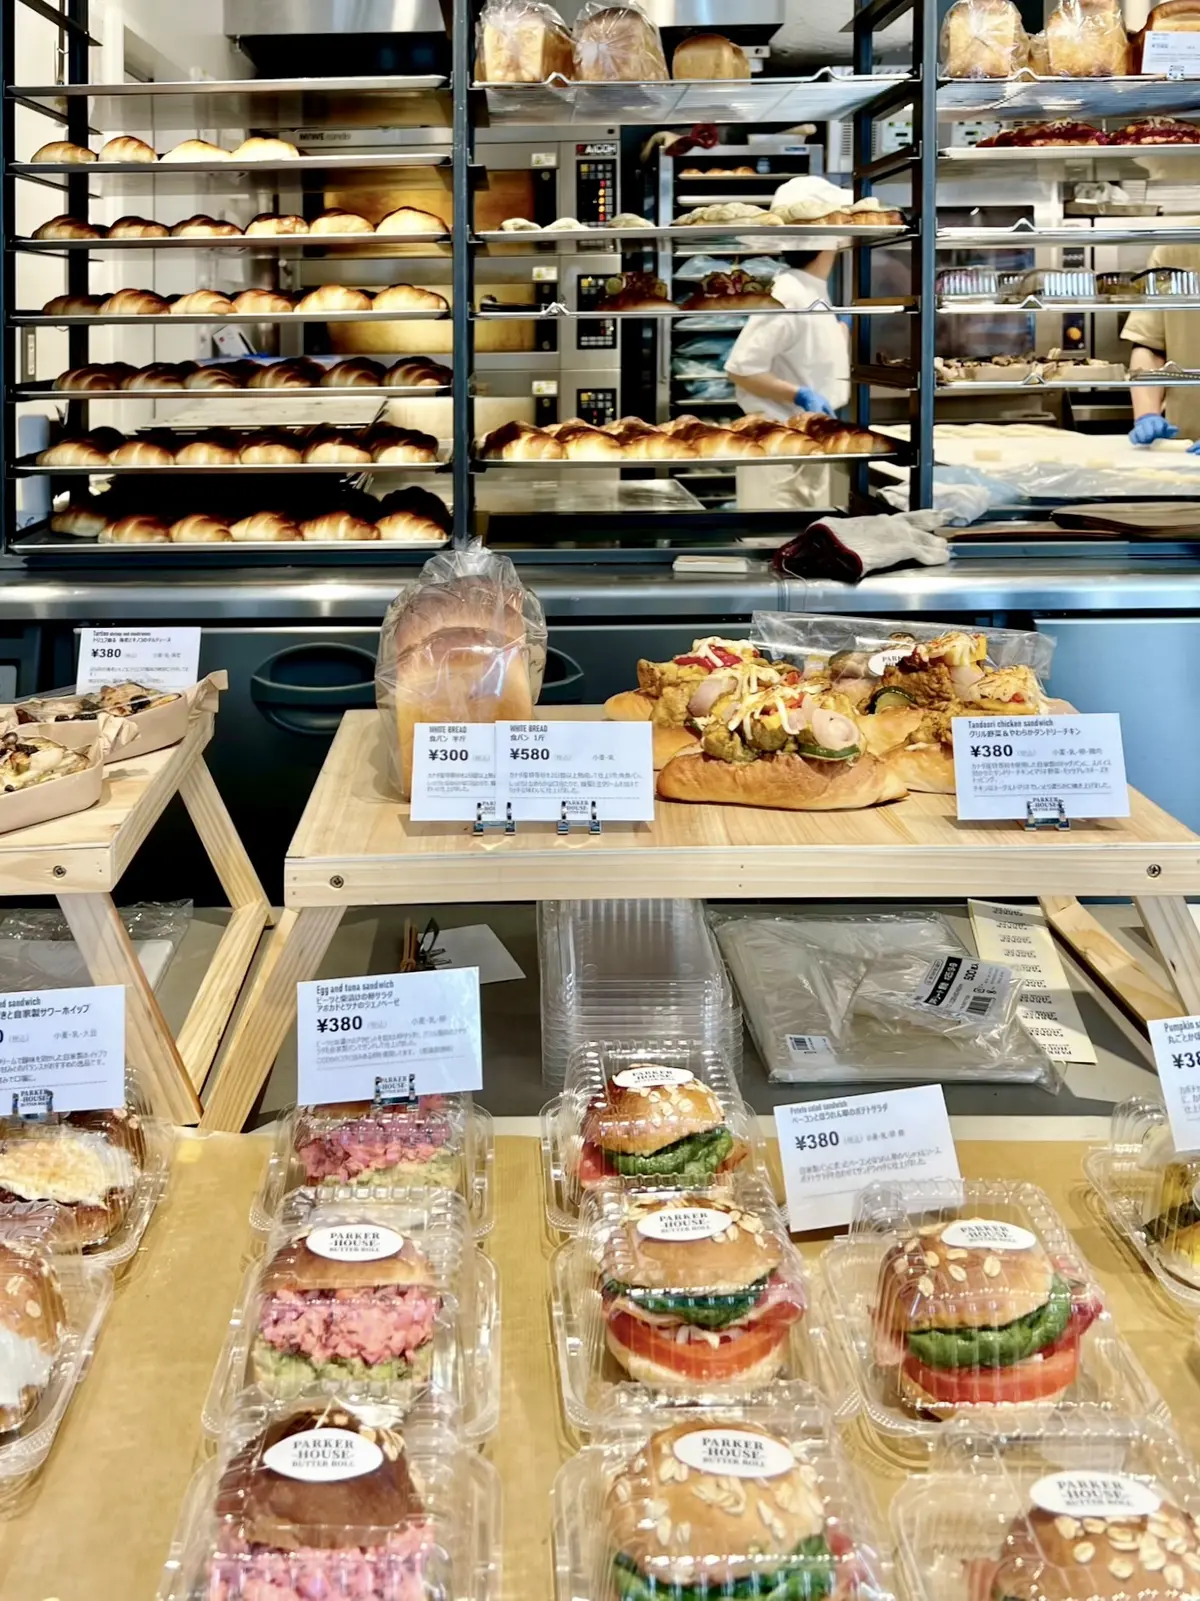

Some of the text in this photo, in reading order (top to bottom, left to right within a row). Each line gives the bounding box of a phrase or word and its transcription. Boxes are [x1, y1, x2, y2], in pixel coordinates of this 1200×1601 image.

[91, 648, 122, 658] ¥380
[997, 720, 1022, 728] chicken
[1023, 719, 1054, 727] sandwich
[428, 749, 468, 761] ¥300
[510, 748, 550, 760] ¥580
[970, 744, 1013, 757] ¥380
[316, 980, 394, 996] Egg and tuna sandwich
[8, 996, 41, 1008] sandwich
[316, 1015, 363, 1033] ¥380
[1164, 1020, 1194, 1033] Pumpkin
[795, 1131, 839, 1151] ¥380
[659, 1212, 708, 1222] PARKER
[293, 1439, 354, 1449] PARKER
[702, 1437, 764, 1450] PARKER
[292, 1460, 355, 1468] BUTTER ROLL
[703, 1457, 765, 1468] BUTTER ROLL
[1057, 1480, 1124, 1490] PARKER
